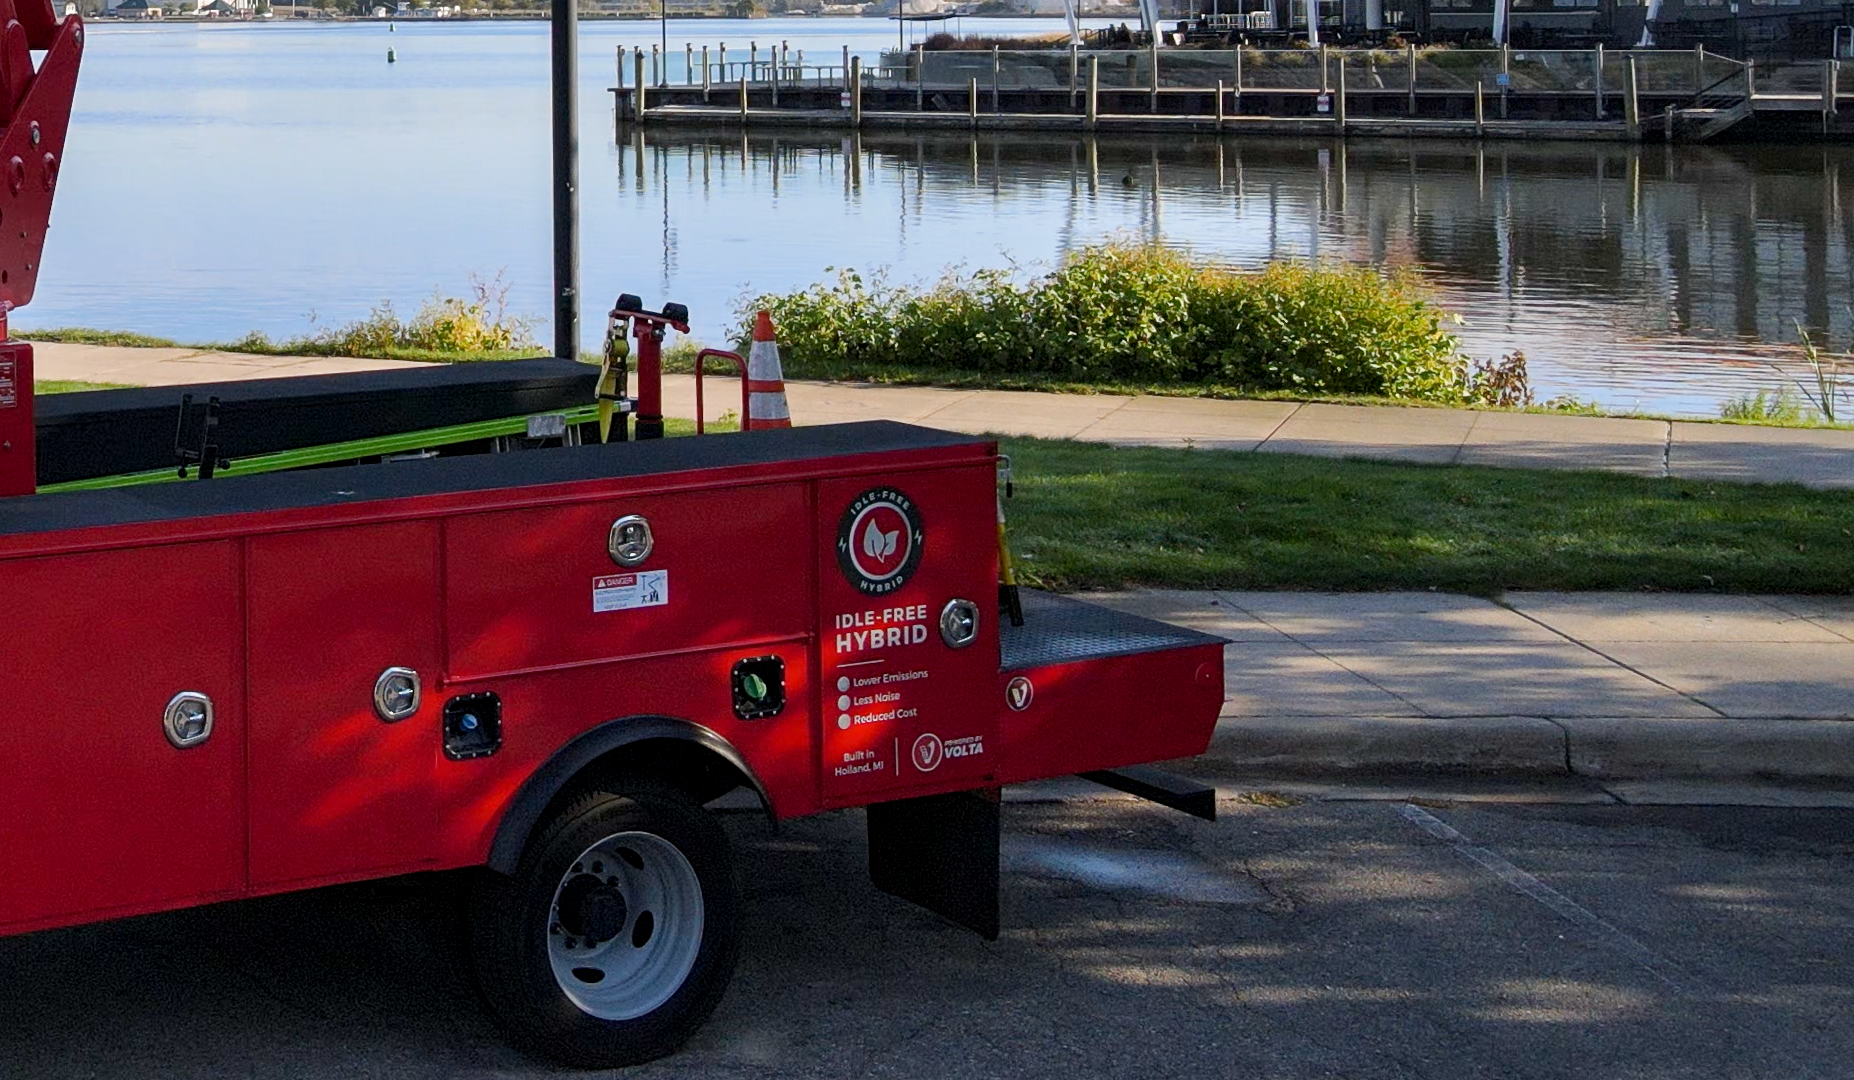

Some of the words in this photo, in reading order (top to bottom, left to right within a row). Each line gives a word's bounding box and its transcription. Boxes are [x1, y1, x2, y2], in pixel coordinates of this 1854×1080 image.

[850, 491, 910, 516] IDLE-FREE
[607, 577, 633, 586] DANGER
[860, 574, 904, 593] HYBRID
[836, 605, 928, 629] IDLE-FREE
[836, 624, 928, 653] HYBRID
[853, 676, 882, 687] Lower
[882, 670, 929, 683] Emissions
[853, 695, 874, 706] Less
[875, 691, 901, 703] Noise
[854, 712, 896, 724] Reduced
[896, 707, 919, 718] Cost
[843, 753, 865, 763] Built
[866, 750, 875, 760] in
[944, 742, 984, 759] VOLTA
[834, 764, 871, 777] Holland,
[872, 761, 884, 769] MI
